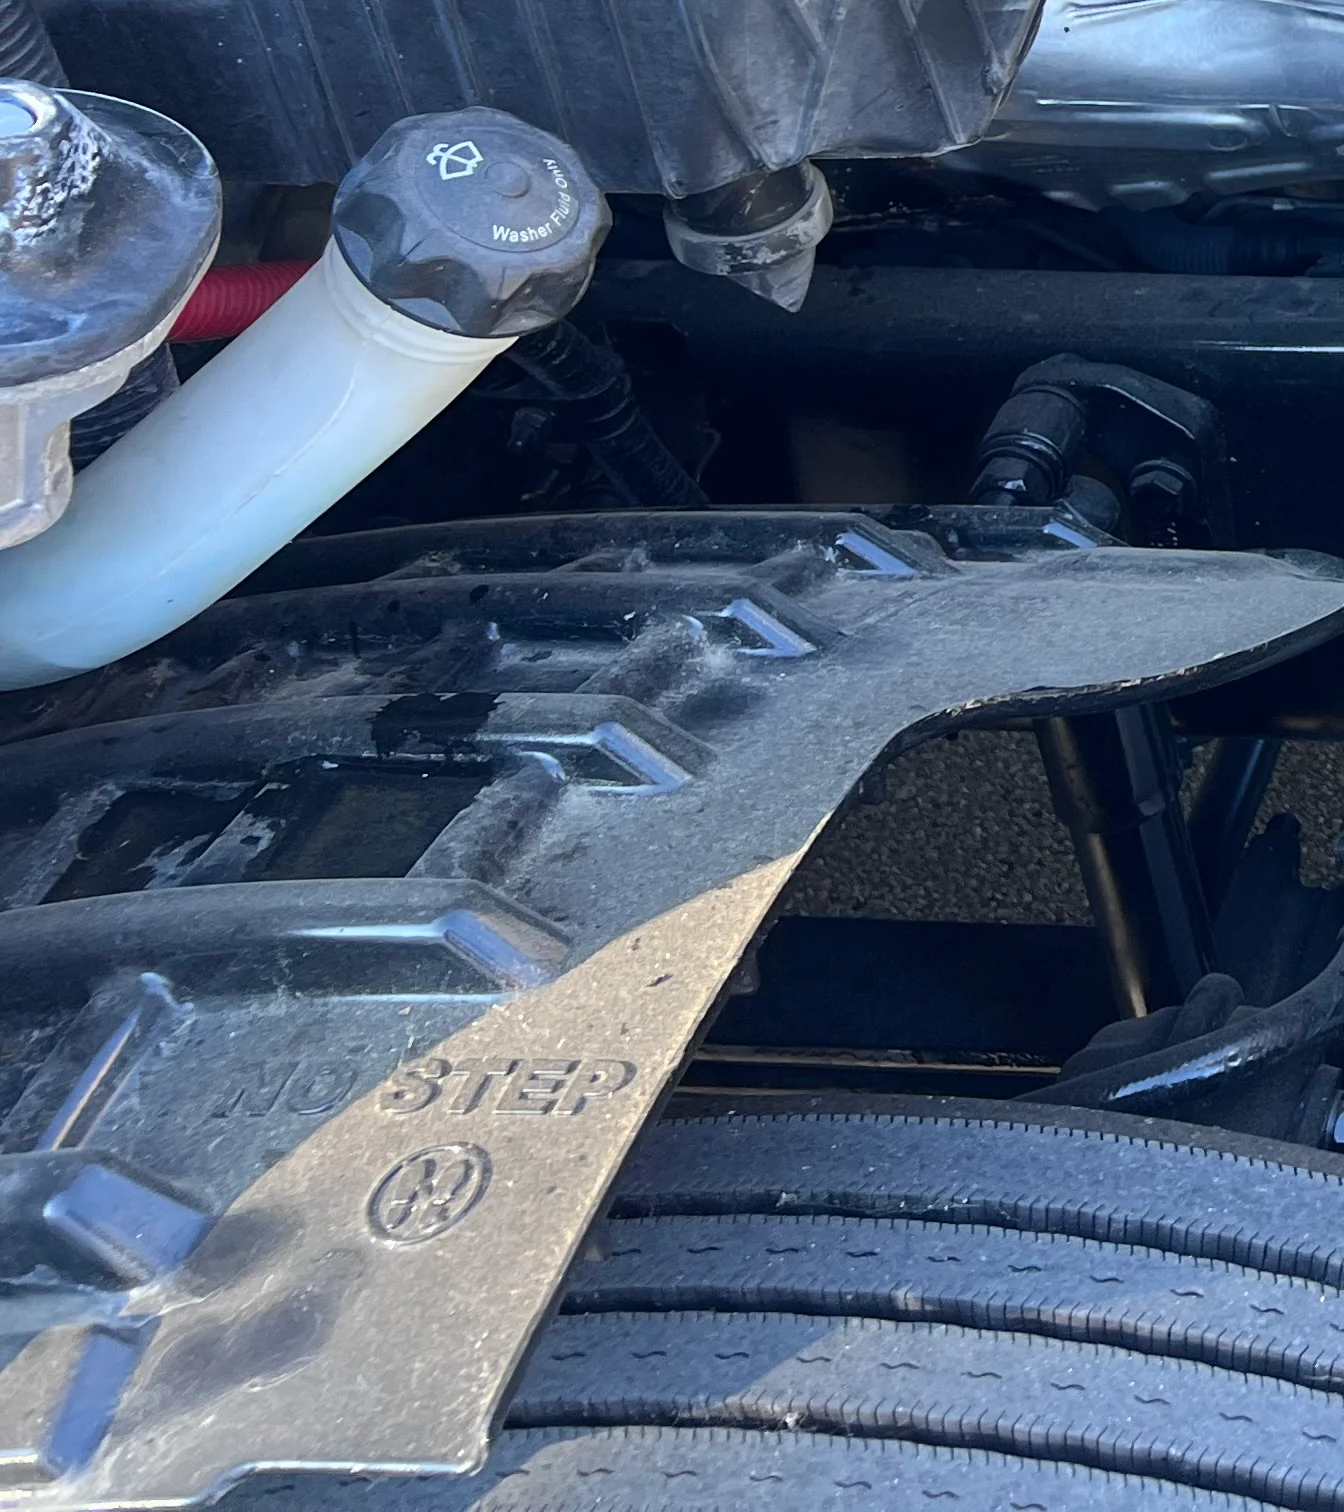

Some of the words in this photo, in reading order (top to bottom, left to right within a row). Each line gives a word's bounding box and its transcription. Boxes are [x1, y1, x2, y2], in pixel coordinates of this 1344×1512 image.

[542, 157, 568, 190] Only
[550, 192, 572, 227] Fluid
[492, 224, 554, 243] Washer
[211, 1060, 360, 1118] NO
[379, 1058, 637, 1118] STEP
